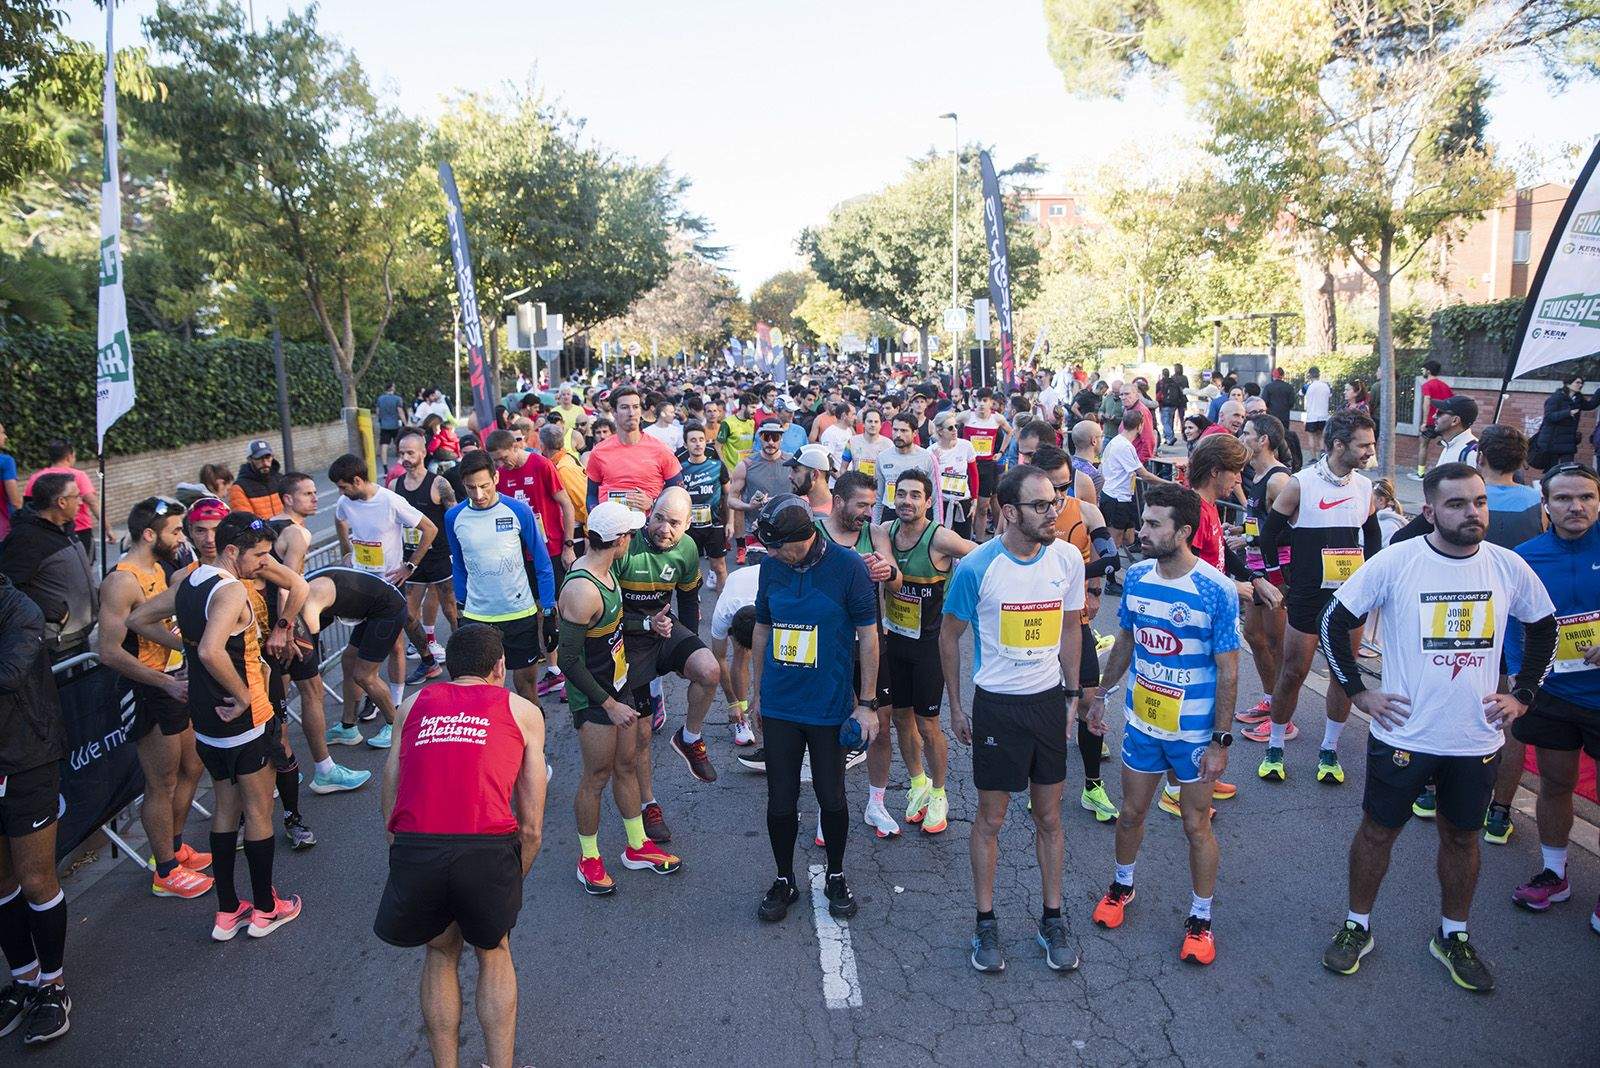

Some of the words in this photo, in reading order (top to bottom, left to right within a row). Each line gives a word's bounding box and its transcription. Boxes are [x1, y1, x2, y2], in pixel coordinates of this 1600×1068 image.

[1544, 329, 1568, 337] KERN
[700, 485, 714, 494] 10K
[921, 587, 932, 597] CH
[1448, 608, 1470, 618] JORDI
[1024, 617, 1042, 627] MARC
[1447, 620, 1472, 632] 2268
[1025, 629, 1040, 641] 845
[1565, 628, 1596, 640] ENRIQUE
[1141, 630, 1172, 651] DANI
[780, 645, 797, 656] 2336
[1433, 655, 1485, 667] CUGAT
[1156, 685, 1173, 695] CUGAT
[1145, 697, 1161, 708] JOSEP
[1148, 707, 1157, 720] 66
[420, 712, 490, 727] barcelona
[418, 723, 488, 739] atletisme
